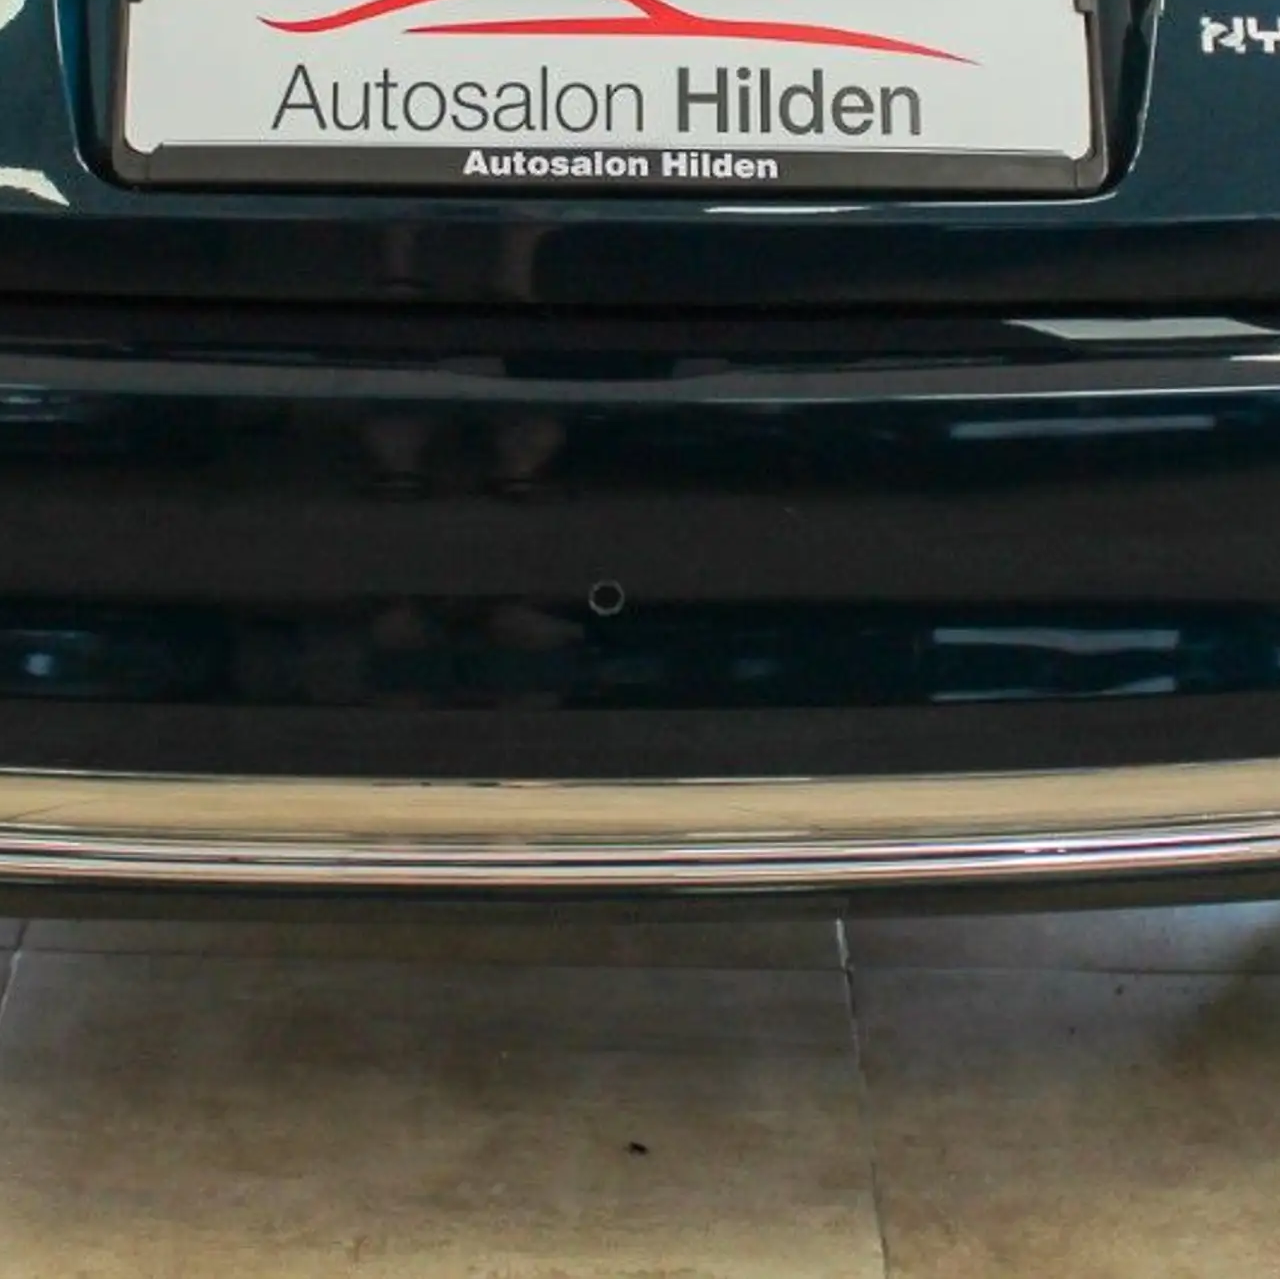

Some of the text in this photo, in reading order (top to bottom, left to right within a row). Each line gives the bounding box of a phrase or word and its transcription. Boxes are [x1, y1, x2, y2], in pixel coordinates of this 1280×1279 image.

[271, 63, 922, 135] Autosalon Hilden
[462, 149, 779, 179] Autosalon Hilden
